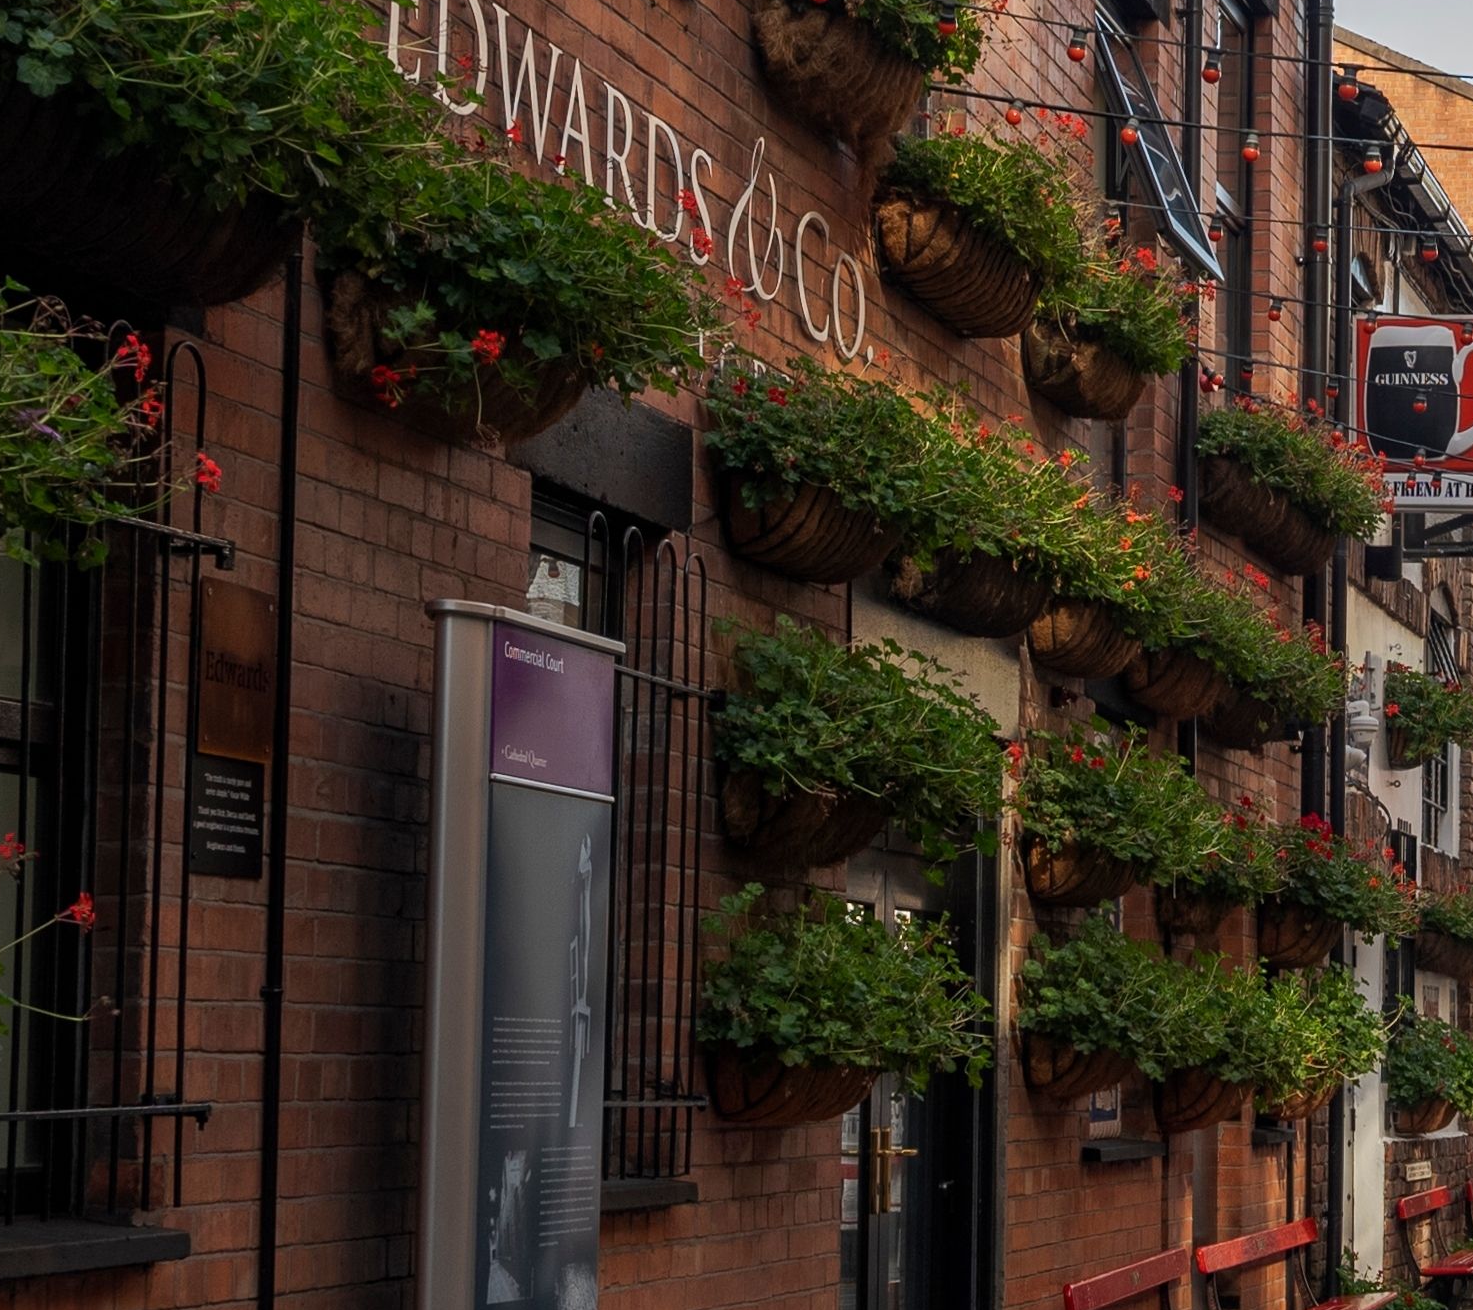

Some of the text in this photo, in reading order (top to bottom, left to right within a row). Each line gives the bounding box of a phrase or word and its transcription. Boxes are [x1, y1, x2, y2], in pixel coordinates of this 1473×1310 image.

[1375, 372, 1449, 386] GUINNESS
[1393, 481, 1441, 498] FRIEND
[1446, 482, 1463, 497] AT
[504, 641, 564, 674] Commercial Court
[205, 651, 271, 692] Edwards
